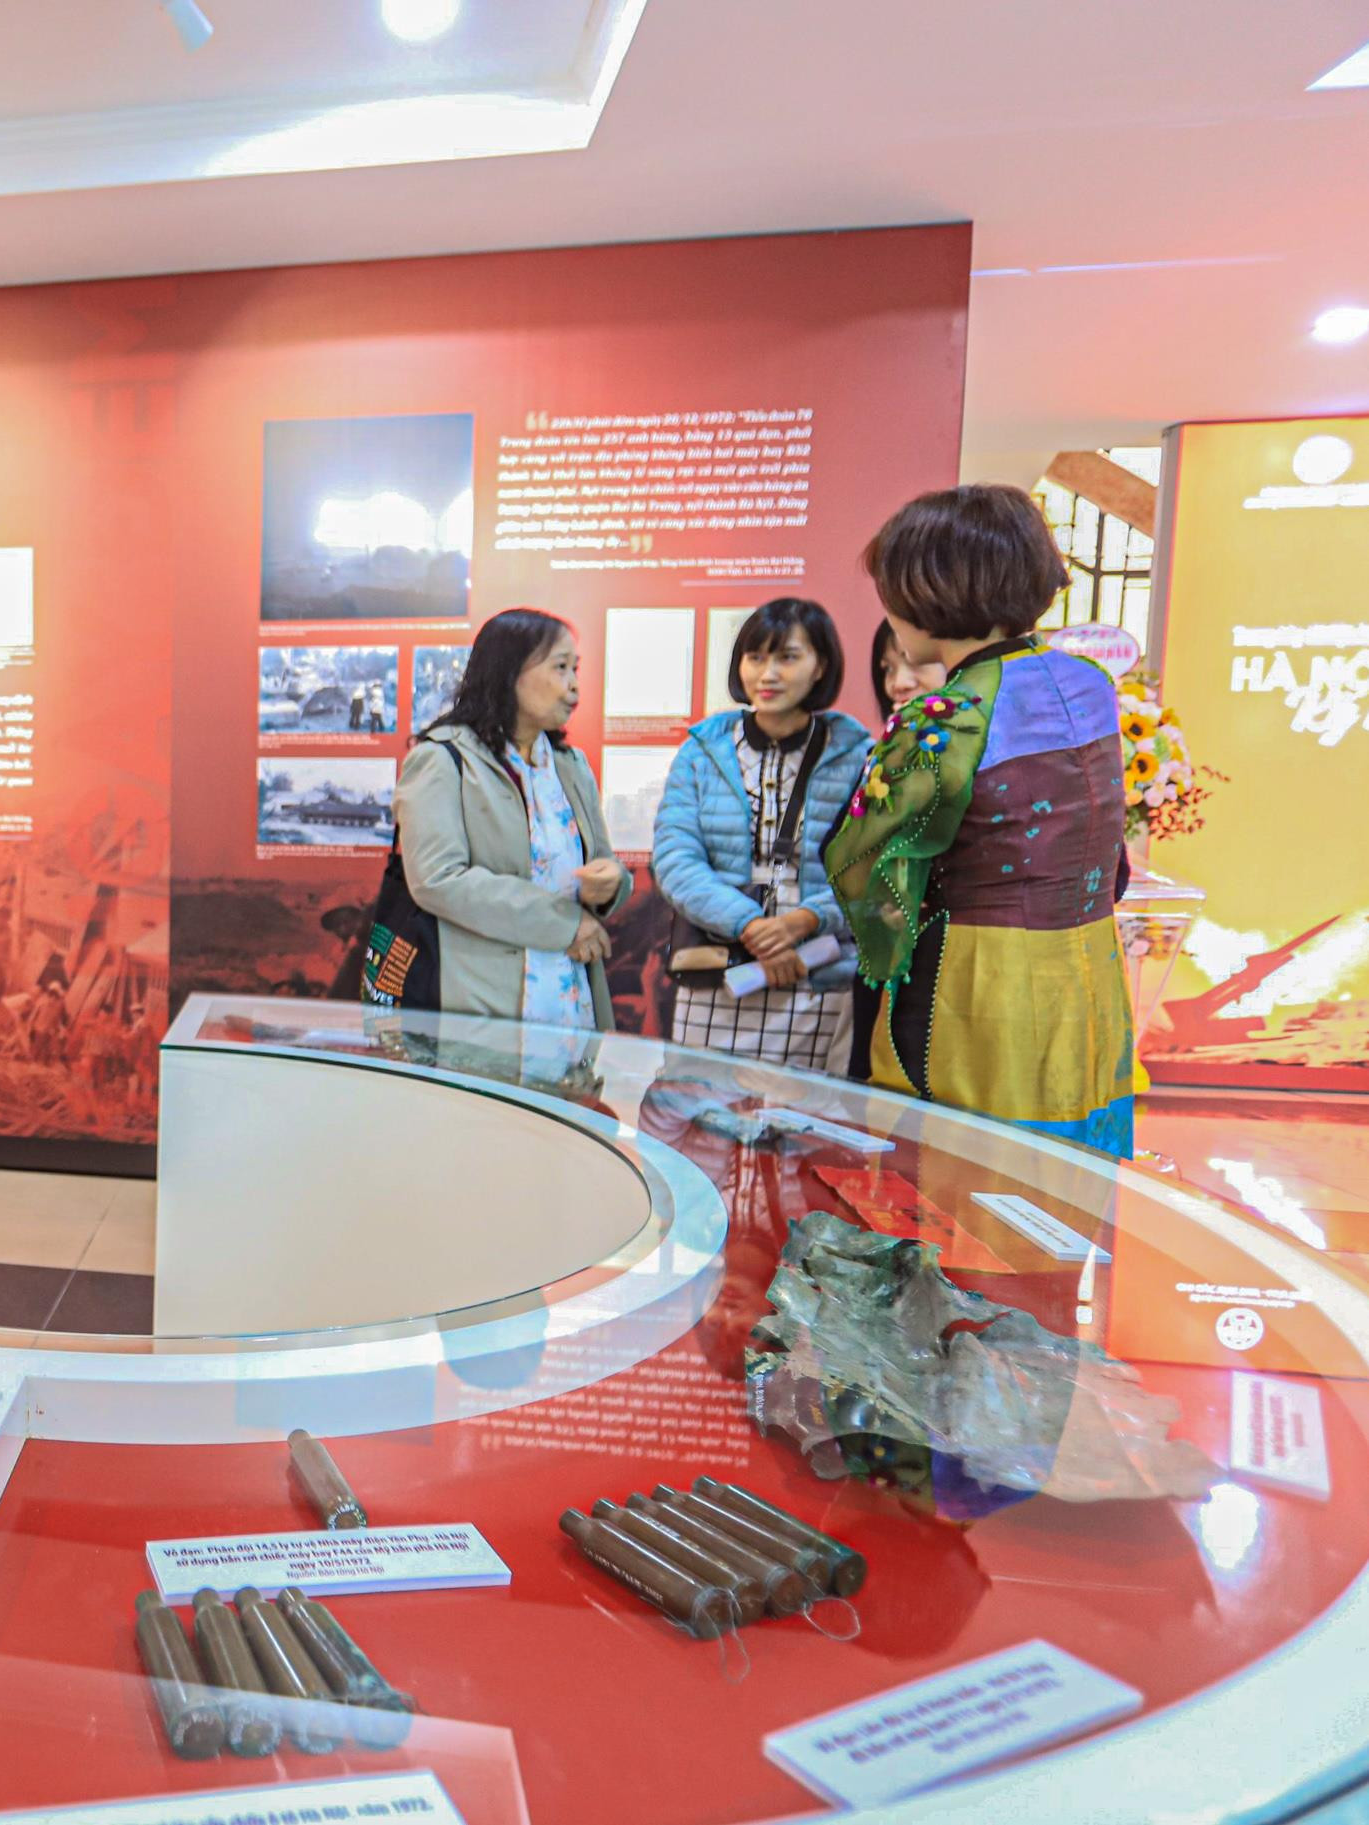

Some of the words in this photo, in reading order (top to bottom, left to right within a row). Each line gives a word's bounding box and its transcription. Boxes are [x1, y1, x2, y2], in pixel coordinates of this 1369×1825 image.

[207, 1545, 235, 1555] Phân
[236, 1543, 254, 1553] đội
[256, 1542, 277, 1552] 14,5
[280, 1542, 289, 1551] ly
[317, 1537, 340, 1547] Nhà
[341, 1537, 363, 1548] máy
[364, 1534, 386, 1546] điện
[386, 1534, 407, 1544] Yên
[407, 1533, 429, 1543] Phụ
[435, 1532, 451, 1541] Hà
[451, 1531, 470, 1542] Nội
[191, 1556, 219, 1568] dụng
[220, 1554, 242, 1564] bắn
[243, 1553, 258, 1563] rơi
[259, 1551, 287, 1562] chiếc
[288, 1550, 310, 1560] máy
[311, 1549, 332, 1560] bay
[355, 1546, 373, 1555] của
[374, 1544, 390, 1556] Mỹ
[391, 1543, 413, 1554] bắn
[434, 1542, 451, 1551] Hà
[451, 1541, 470, 1552] Nội
[289, 1561, 316, 1571] ngày
[319, 1557, 372, 1569] 10/5/1972
[356, 1566, 370, 1575] Hà
[370, 1565, 385, 1575] Nội
